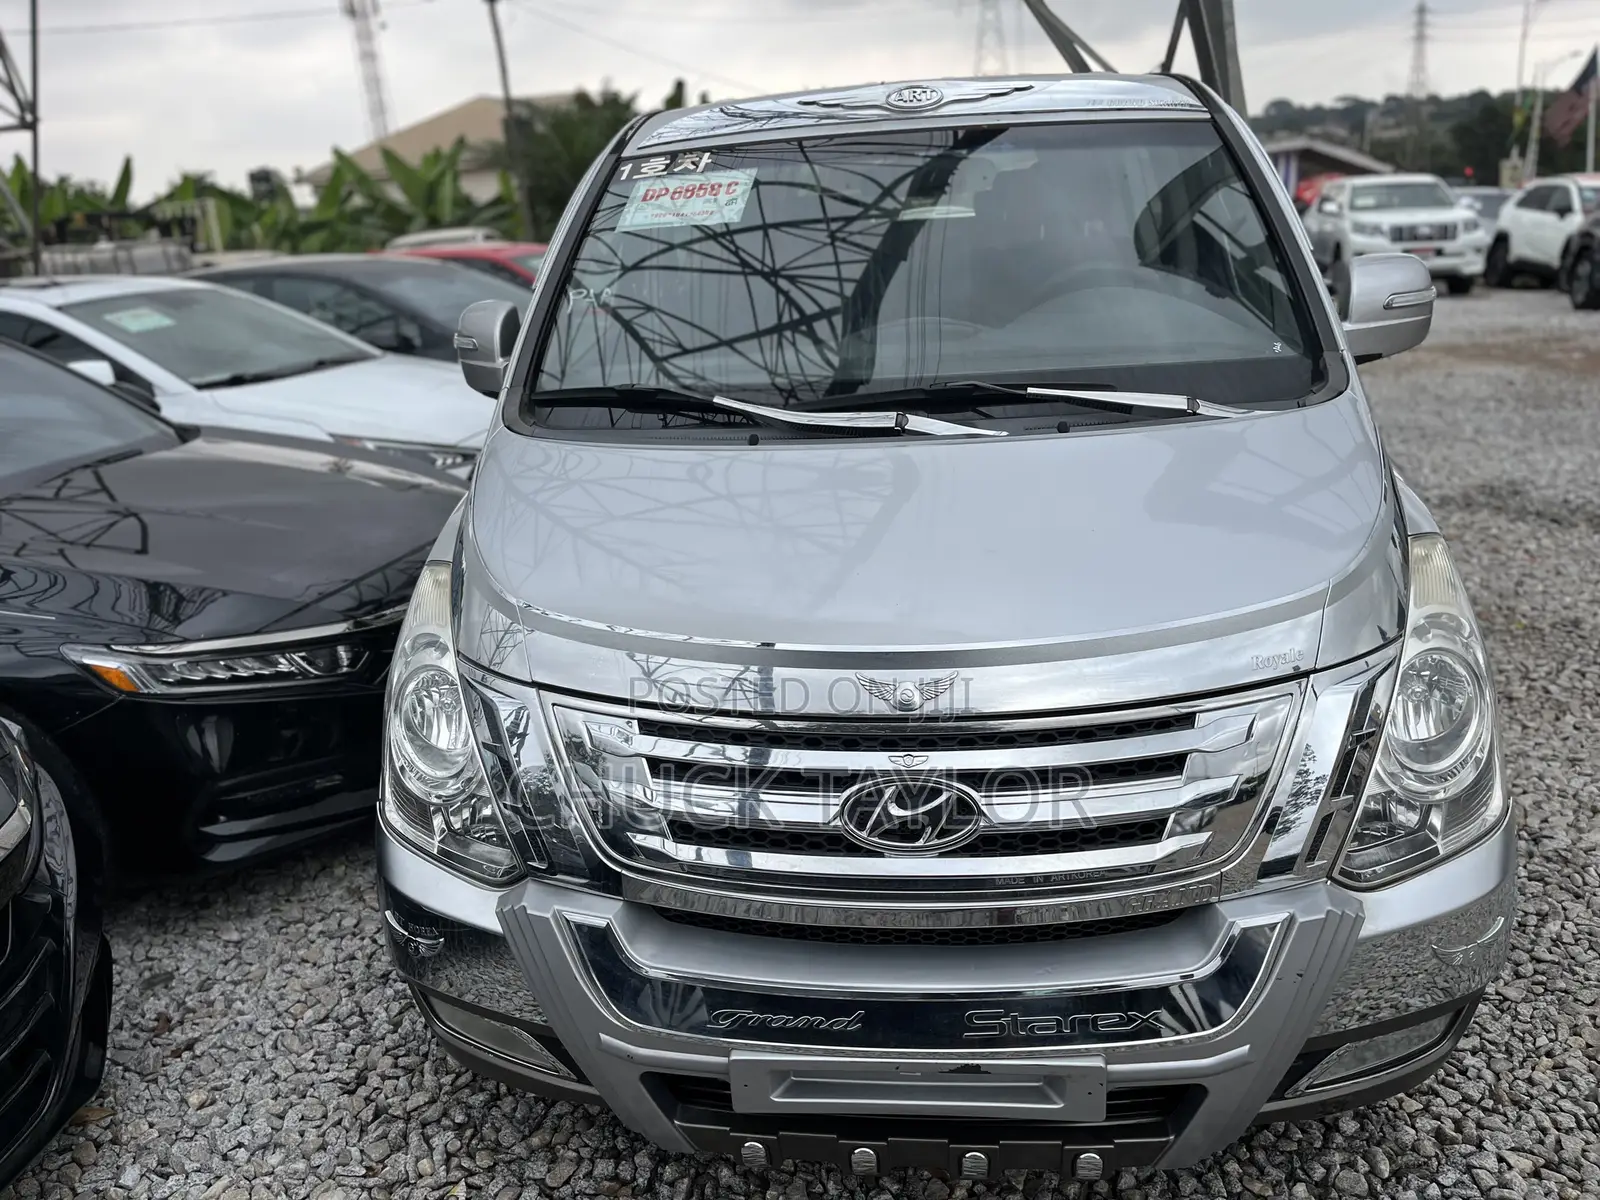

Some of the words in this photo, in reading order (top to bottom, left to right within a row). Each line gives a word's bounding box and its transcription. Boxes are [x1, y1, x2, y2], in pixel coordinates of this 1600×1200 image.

[890, 89, 934, 103] ART
[620, 151, 713, 181] 1호차
[1250, 647, 1305, 671] Royale
[995, 877, 1026, 886] MADE
[1033, 875, 1044, 884] IN
[706, 1008, 865, 1032] Grand
[962, 1008, 1167, 1039] Starex
